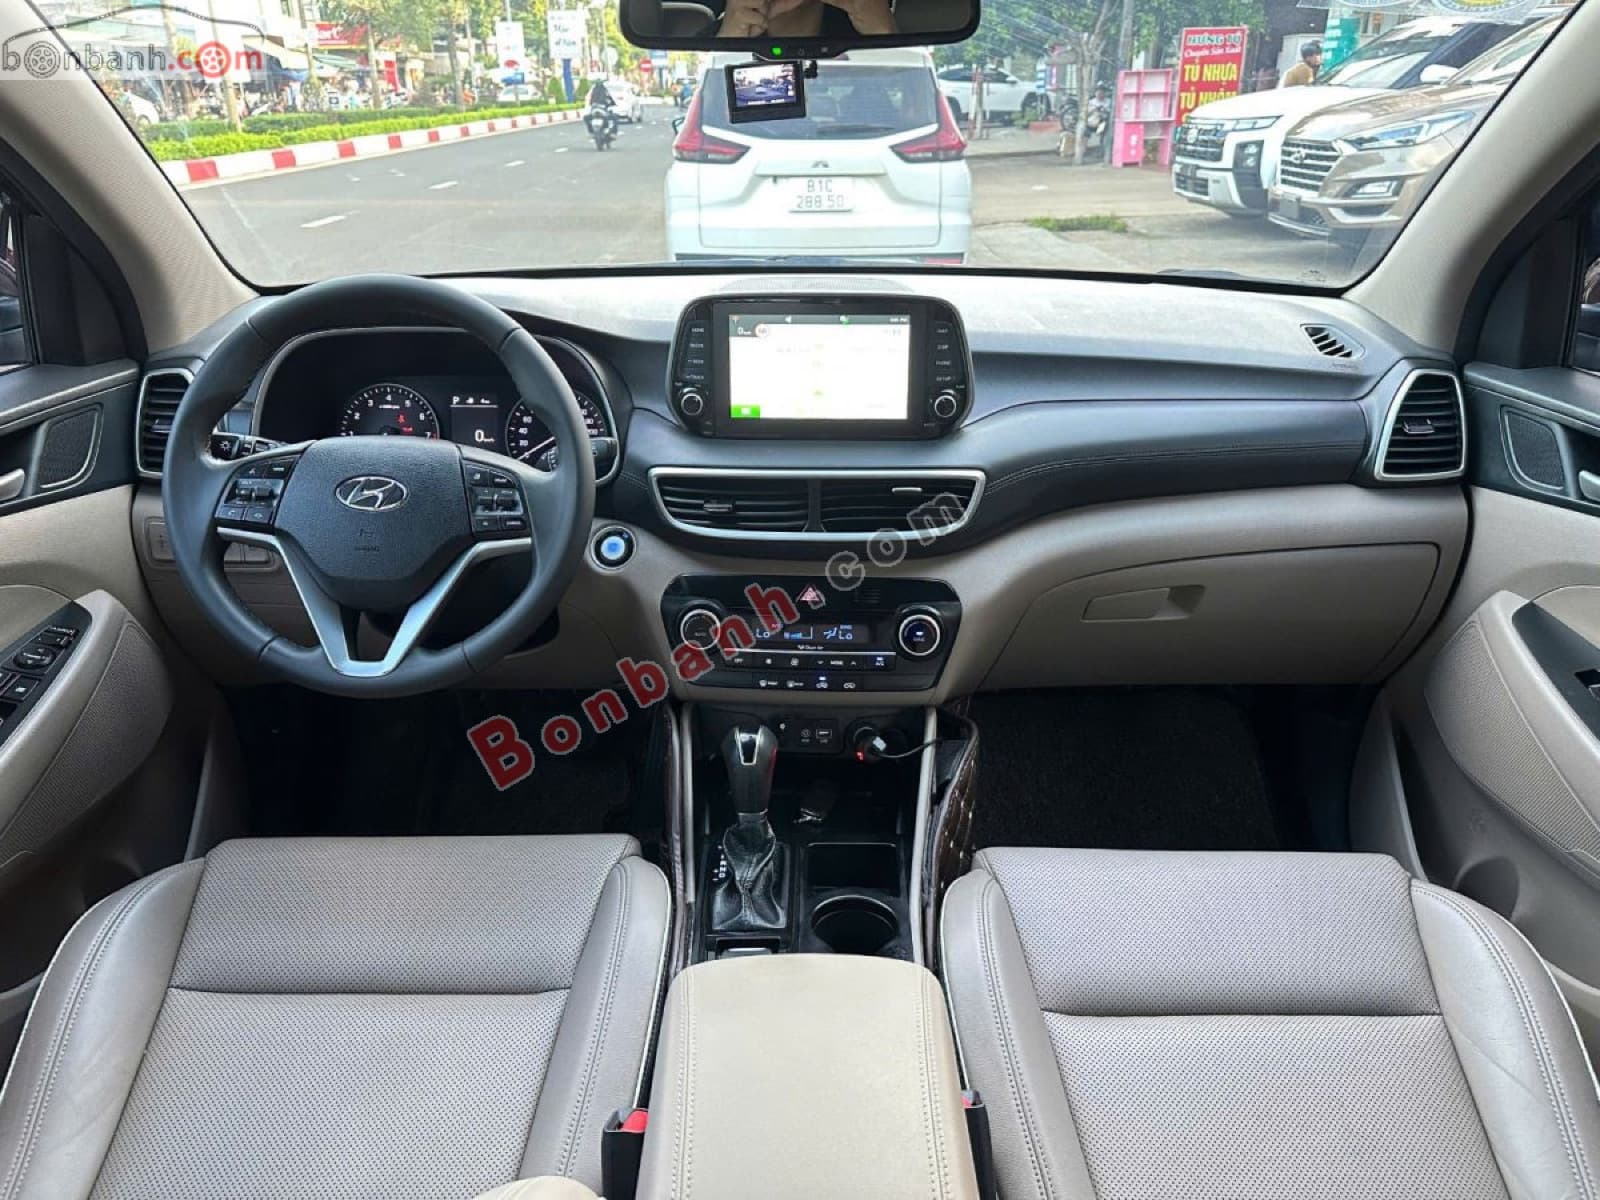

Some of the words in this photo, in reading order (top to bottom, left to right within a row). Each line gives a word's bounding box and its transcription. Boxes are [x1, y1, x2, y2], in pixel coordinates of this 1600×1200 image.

[1184, 58, 1200, 82] TỦ
[1202, 62, 1237, 85] NHỰA
[1180, 86, 1196, 109] TỦ
